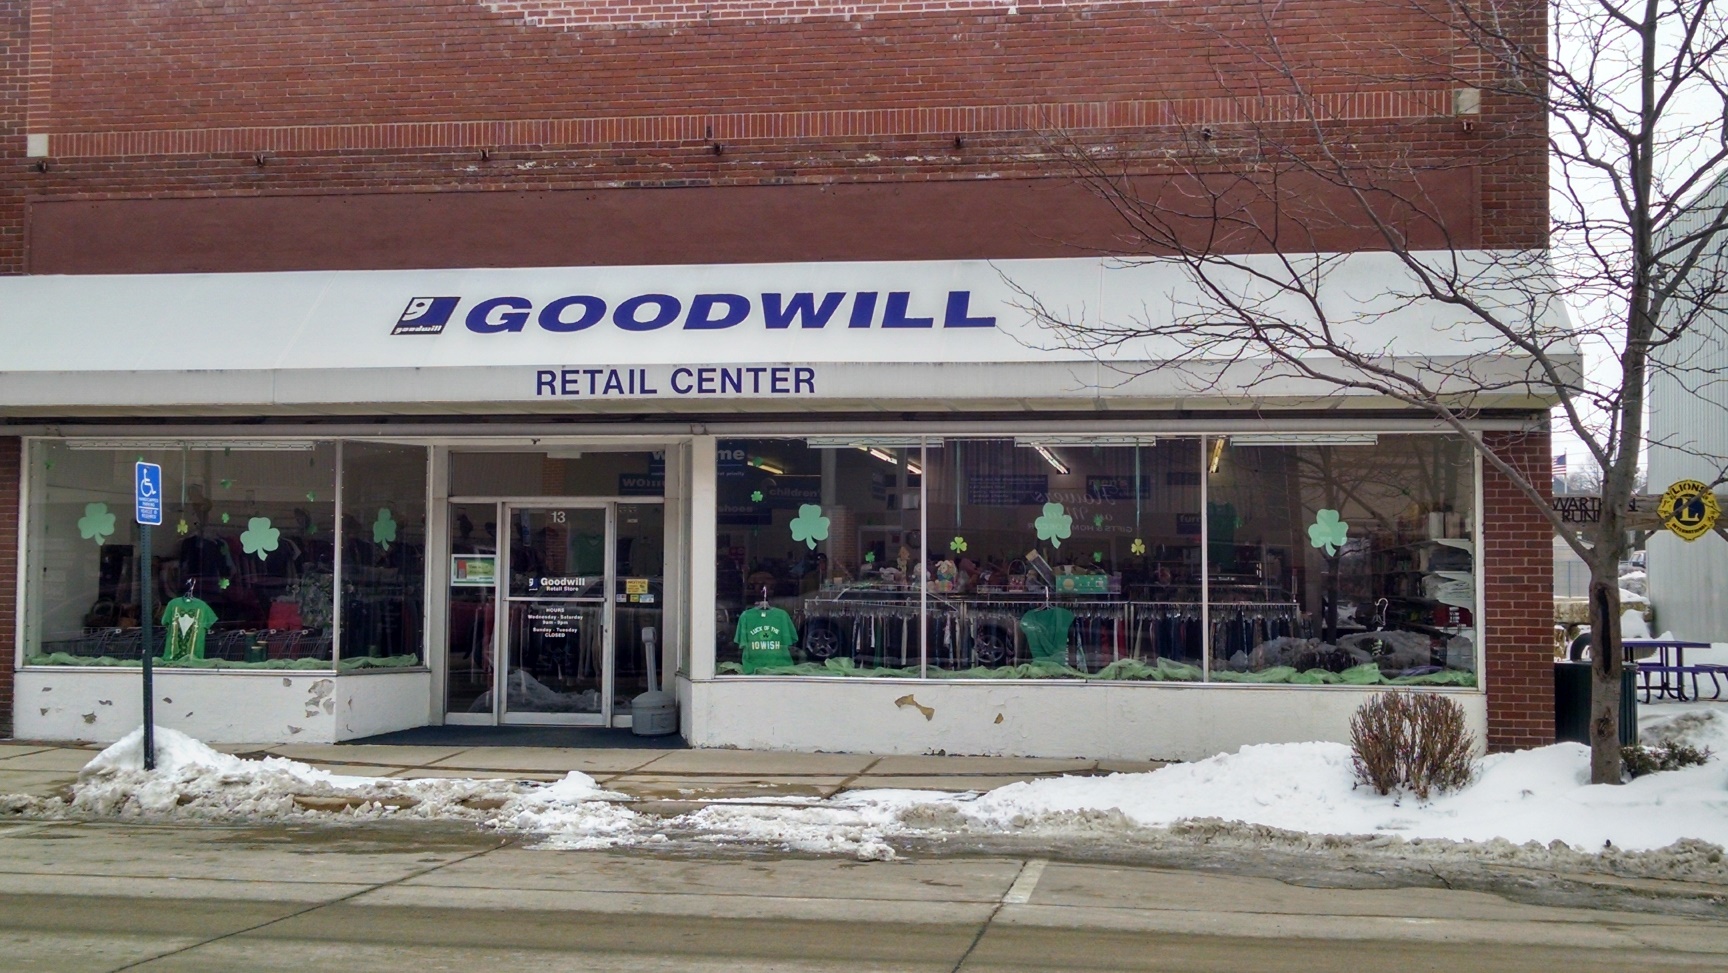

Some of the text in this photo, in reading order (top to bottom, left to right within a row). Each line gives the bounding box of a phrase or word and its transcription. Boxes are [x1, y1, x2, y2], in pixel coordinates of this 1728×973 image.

[465, 291, 996, 333] GOODWILL
[536, 368, 815, 395] RETAIL CENTER
[769, 487, 822, 498] children'
[551, 511, 566, 523] 13
[540, 577, 586, 586] Goodwill
[752, 641, 780, 650] IOWISH
